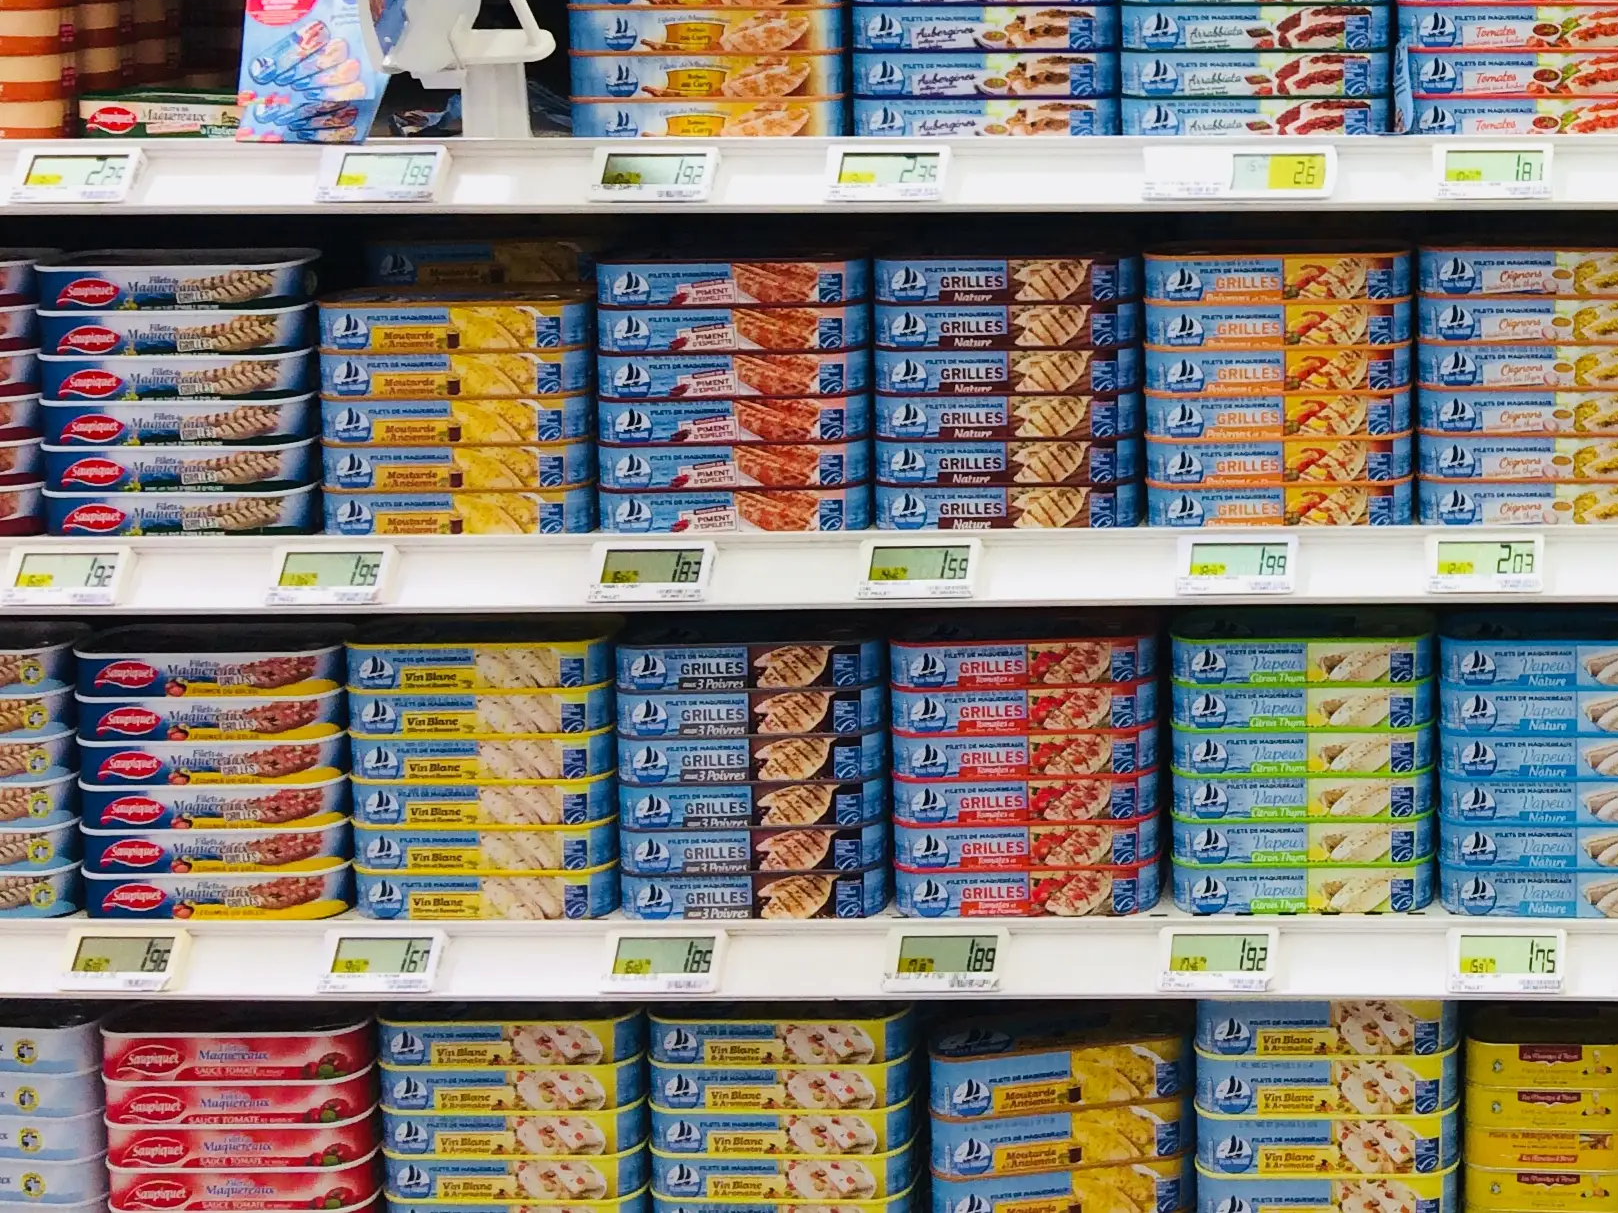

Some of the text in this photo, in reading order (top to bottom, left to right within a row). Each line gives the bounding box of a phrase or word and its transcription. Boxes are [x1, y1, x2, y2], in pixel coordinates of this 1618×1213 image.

[91, 111, 136, 128] Saupiquet
[142, 108, 206, 124] Maquereaux
[1500, 269, 1543, 282] Oignons
[68, 283, 115, 301] Saupiquet
[128, 281, 202, 294] Maquereaux
[953, 292, 992, 303] Nature
[697, 469, 730, 478] PIMENT
[106, 669, 156, 683] Saupiquet
[168, 665, 241, 677] Maquereaux
[405, 673, 457, 682] Vin Blanc
[1528, 675, 1566, 686] Nature
[707, 724, 745, 735] Poivres
[1263, 1035, 1314, 1044] Vin Blanc
[128, 1053, 179, 1067] Saupiquet
[199, 1051, 269, 1061] Maquereaux
